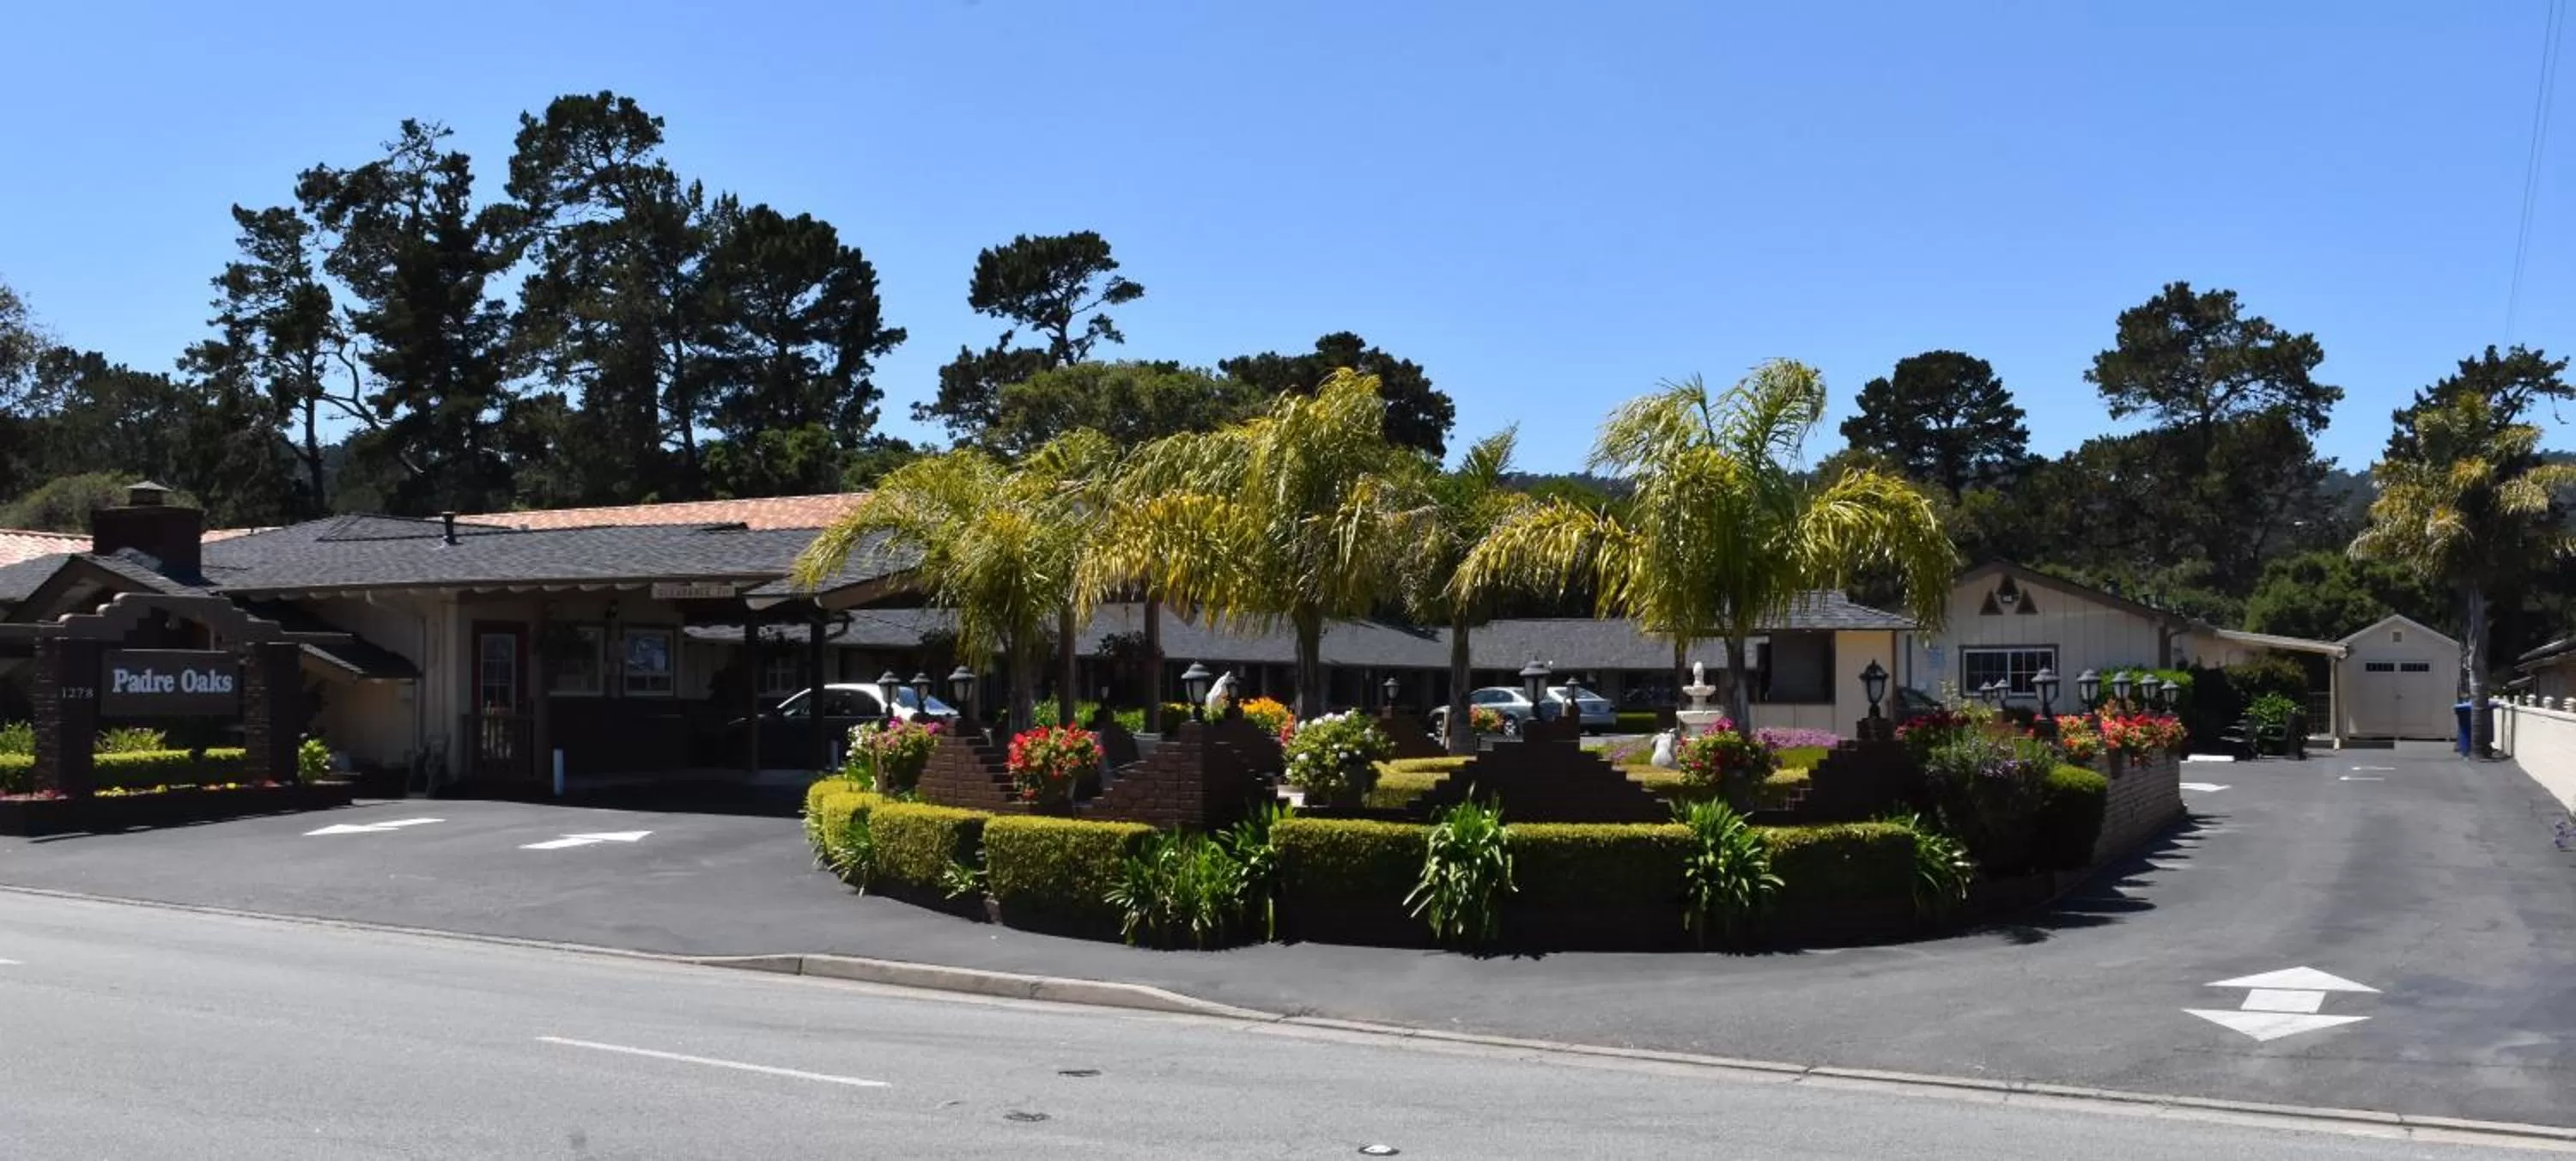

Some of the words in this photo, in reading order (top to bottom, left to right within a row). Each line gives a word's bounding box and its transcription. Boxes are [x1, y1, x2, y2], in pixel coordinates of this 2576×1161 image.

[112, 668, 174, 693] Padre
[180, 668, 233, 693] Oaks
[62, 687, 94, 699] 1278
